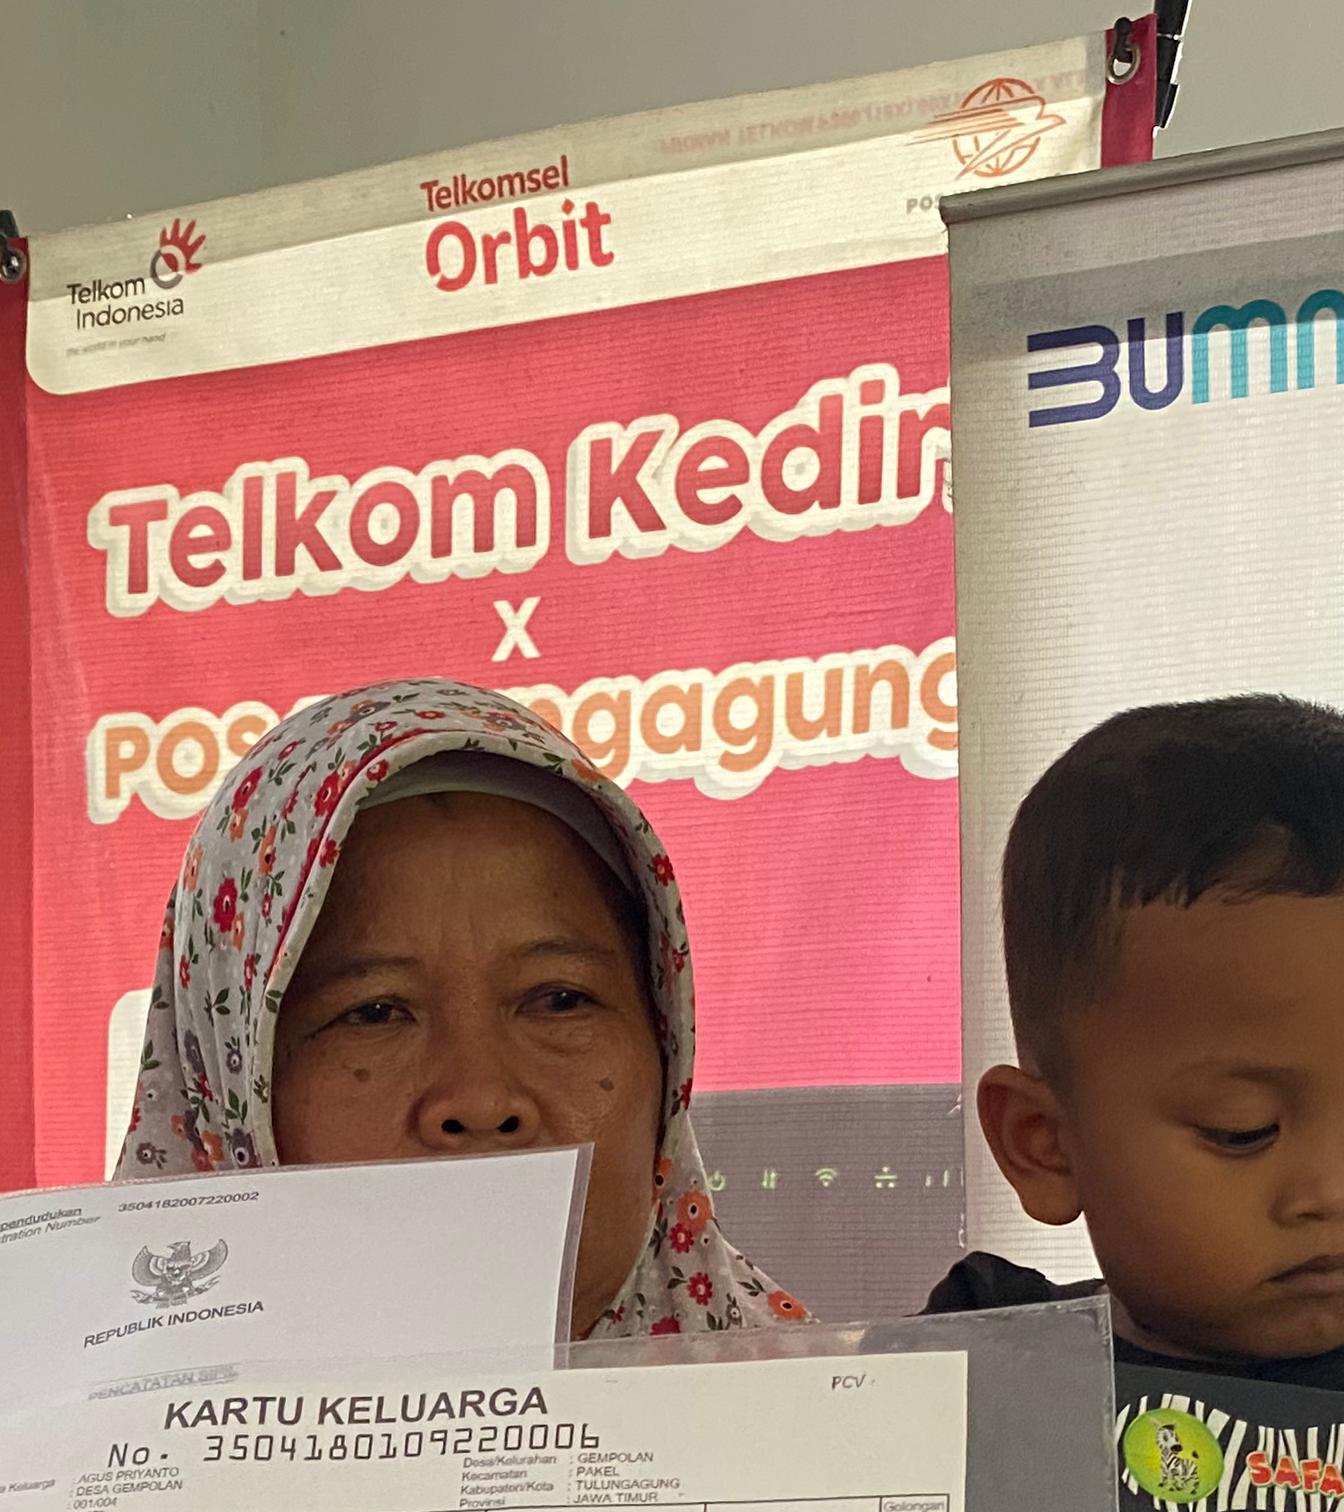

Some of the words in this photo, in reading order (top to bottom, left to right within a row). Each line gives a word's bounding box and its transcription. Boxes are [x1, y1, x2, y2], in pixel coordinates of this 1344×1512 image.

[419, 154, 569, 212] Telkomsel
[426, 198, 615, 292] Orbit
[67, 277, 145, 305] Telkom
[77, 298, 184, 330] Indonesia
[107, 461, 538, 596] Telkom
[588, 377, 951, 540] Kedir
[44, 1213, 102, 1234] Number
[83, 1314, 165, 1349] REPUBLIK
[166, 1299, 265, 1328] INDONESIA
[163, 1397, 307, 1430] KARTU
[316, 1386, 549, 1426] KELUARGA
[108, 1442, 170, 1468] No.
[202, 1422, 602, 1462] 3504180109220006
[577, 1452, 654, 1464] GEMPOLAN
[77, 1471, 113, 1484] AGUS
[115, 1467, 180, 1481] PRIYANTO
[575, 1478, 682, 1491] TULUNGAGUNG
[576, 1466, 620, 1477] PAKEL
[76, 1484, 110, 1497] DESA
[111, 1480, 184, 1495] GEMPOLAN
[573, 1493, 612, 1504] JAWA
[614, 1492, 659, 1503] TIMUR
